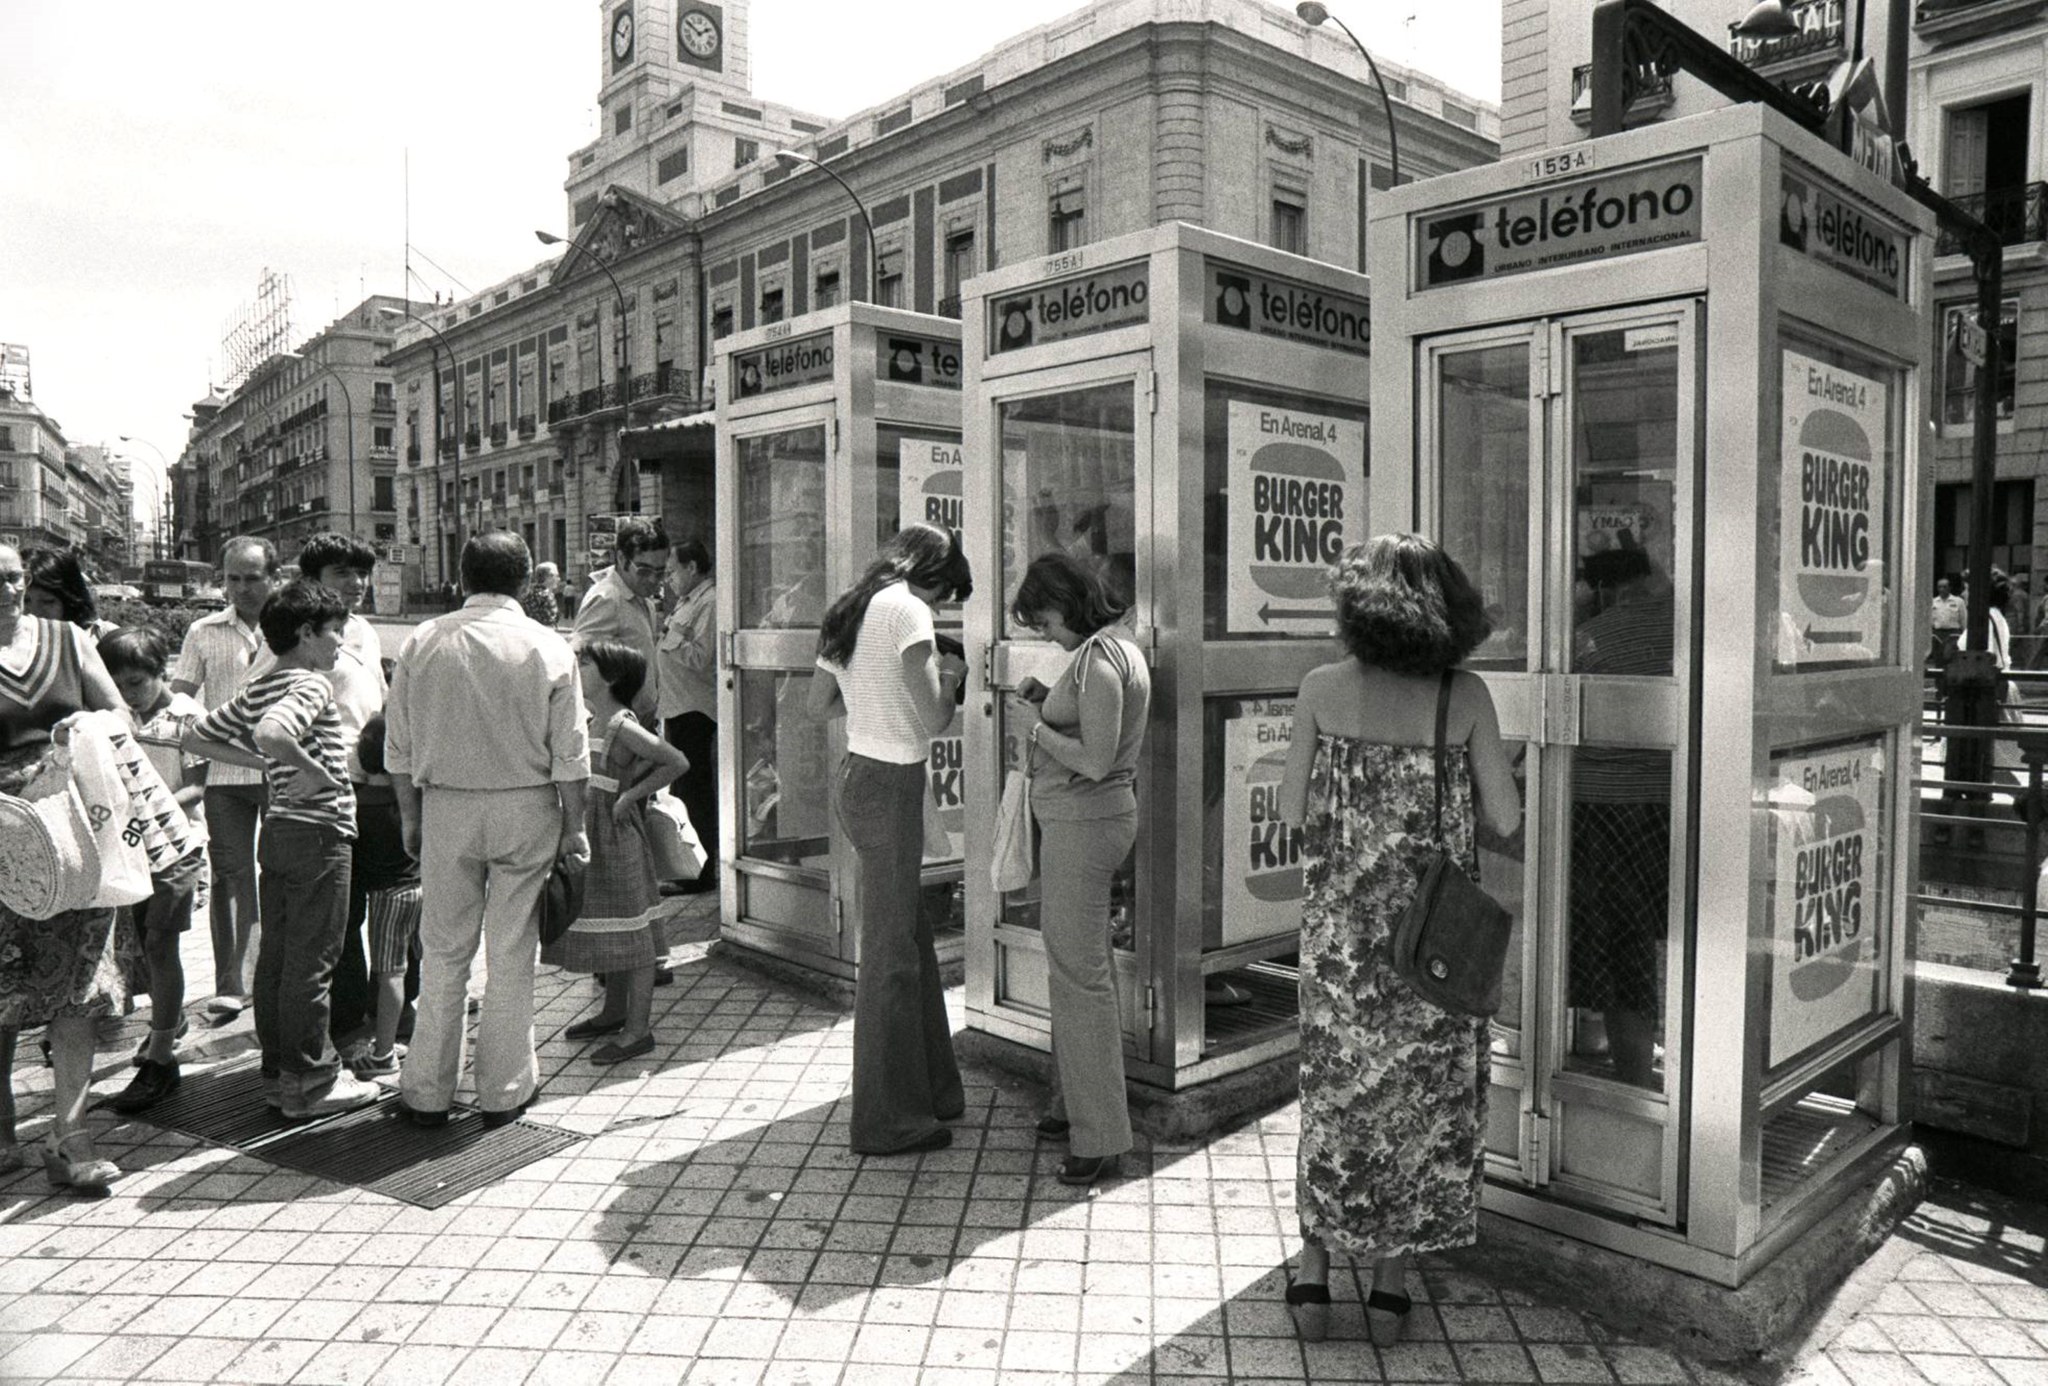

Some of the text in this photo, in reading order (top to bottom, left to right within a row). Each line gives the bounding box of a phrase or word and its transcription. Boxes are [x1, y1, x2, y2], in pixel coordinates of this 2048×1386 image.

[1729, 3, 1842, 55] HTAL
[1495, 183, 1693, 249] teléfono
[1815, 192, 1899, 279] teléfono
[1494, 230, 1692, 273] URBANO INTERURBANO INTERNACIONAL
[1037, 279, 1149, 325] teléfono
[1260, 283, 1371, 343] teléfono
[766, 345, 833, 377] teléfono
[1808, 366, 1822, 398] En
[1858, 385, 1866, 410] 4
[1261, 412, 1337, 445] En Arenal, 4
[931, 446, 950, 464] En
[1254, 475, 1344, 519] BURGER
[1801, 452, 1869, 512] BURGER
[925, 496, 963, 529] BU
[1254, 514, 1344, 566] KING
[1801, 504, 1869, 572] KING
[1257, 723, 1276, 744] En
[1803, 766, 1817, 793] En
[1853, 758, 1861, 782] 4
[1795, 834, 1863, 900] BURGER
[1794, 880, 1862, 963] KING
